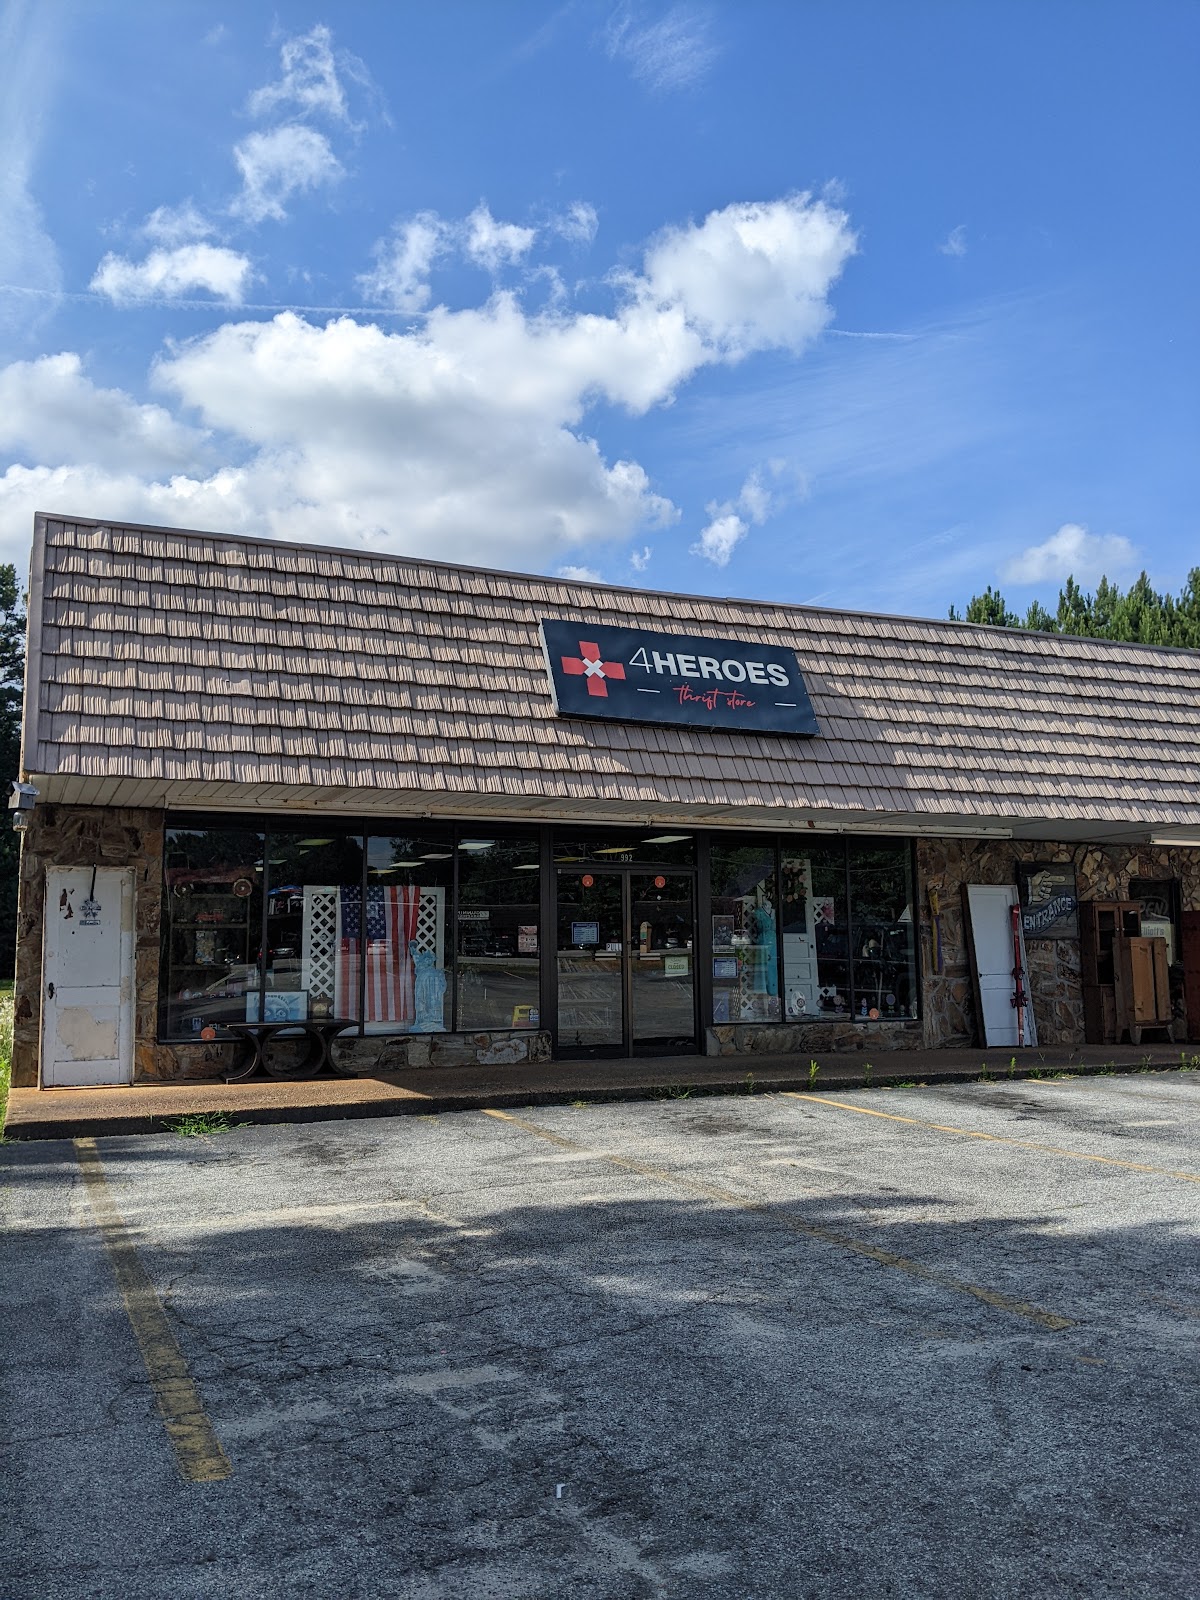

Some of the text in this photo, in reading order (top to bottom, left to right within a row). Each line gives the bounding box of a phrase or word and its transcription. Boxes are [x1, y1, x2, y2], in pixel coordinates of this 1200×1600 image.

[628, 647, 790, 687] 4HEROES
[672, 685, 756, 711] thrift store
[620, 853, 633, 862] 992
[1023, 896, 1073, 930] ENTRANCE
[1139, 901, 1164, 916] PEN
[607, 943, 621, 951] PULL
